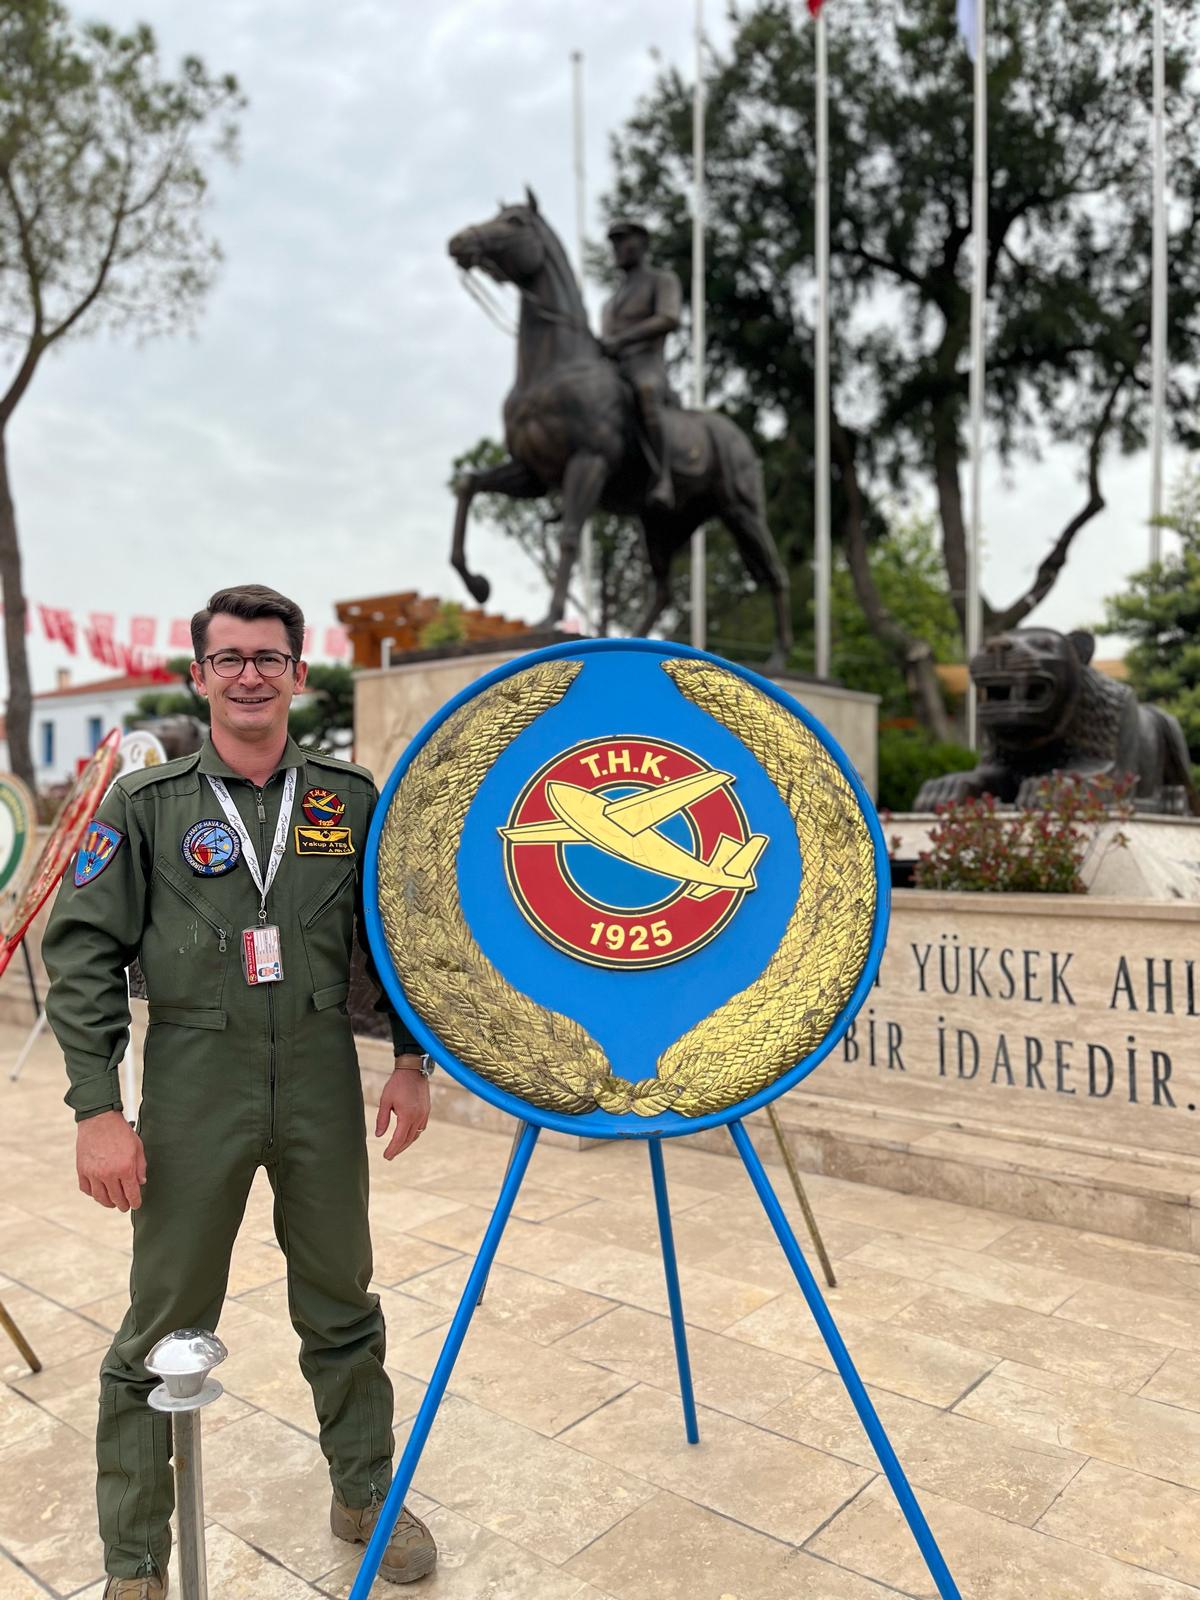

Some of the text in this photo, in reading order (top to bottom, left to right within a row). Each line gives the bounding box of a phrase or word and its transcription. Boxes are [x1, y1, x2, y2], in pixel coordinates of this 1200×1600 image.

[580, 750, 671, 782] T.H.K.
[589, 920, 673, 951] 1925
[911, 934, 1076, 1005] YÜKSEK
[843, 1008, 1197, 1111] BİR İDAREDİR.
